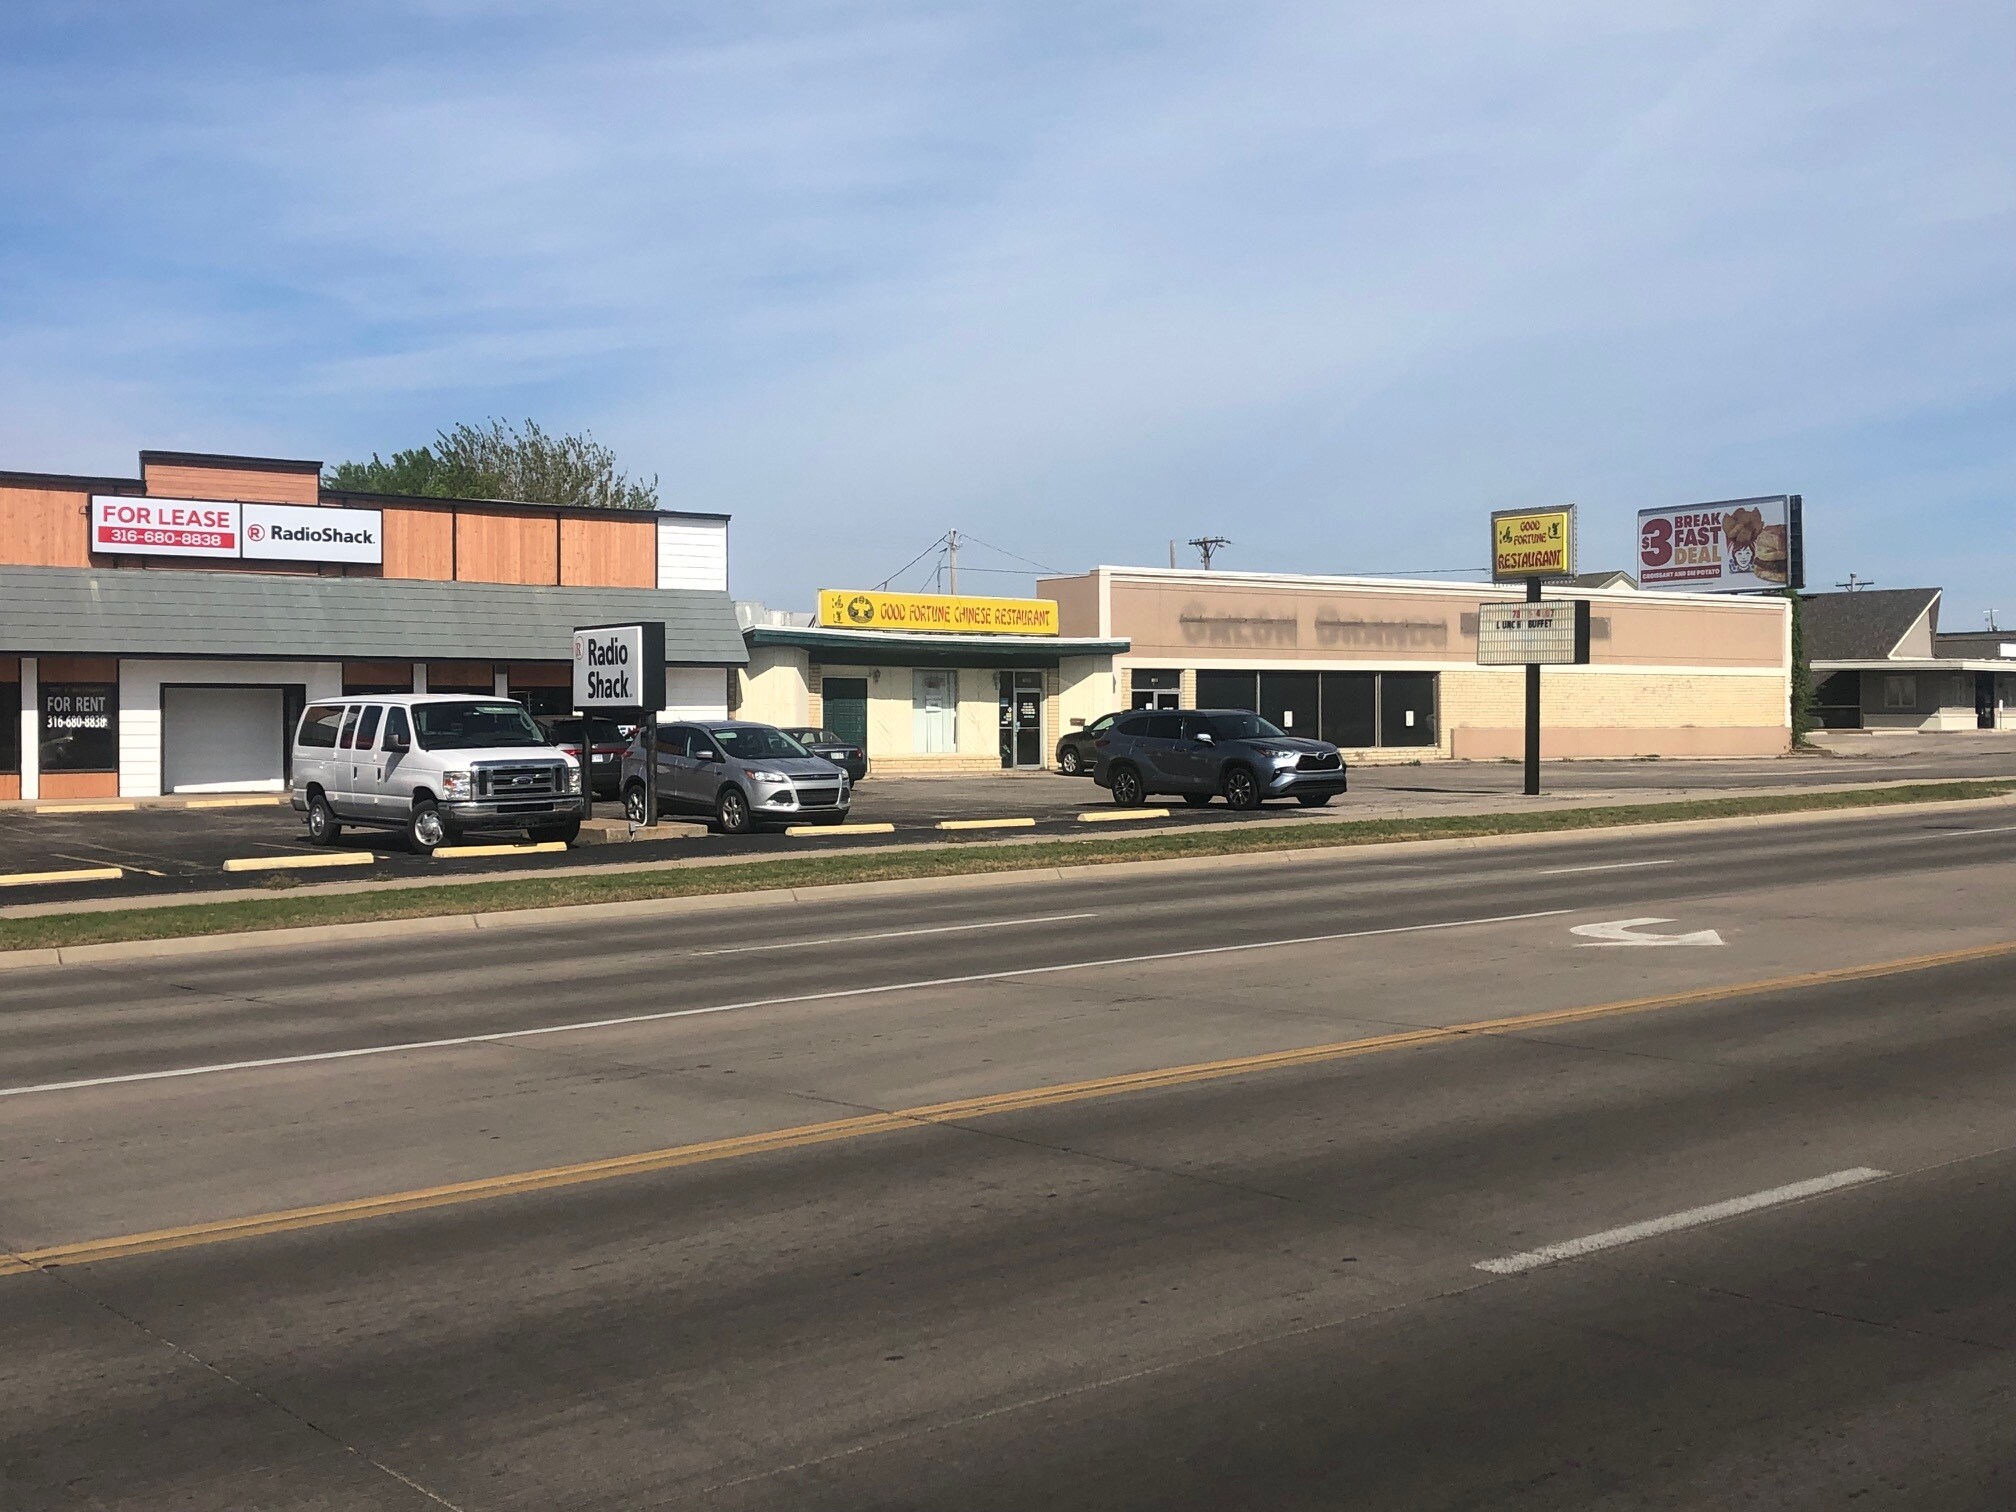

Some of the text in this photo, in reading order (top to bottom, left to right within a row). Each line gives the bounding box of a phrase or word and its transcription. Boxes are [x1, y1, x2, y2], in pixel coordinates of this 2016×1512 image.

[103, 505, 230, 528] FOR LEASE
[1674, 512, 1721, 529] BREAK
[1520, 520, 1540, 532] GOOD
[111, 529, 222, 546] 316-680-8838
[1513, 532, 1547, 545] FORTUNE
[1674, 526, 1721, 547] FAST
[1498, 549, 1562, 569] RESTAURANT
[1674, 545, 1721, 565] DEAL
[1696, 568, 1720, 576] POTATO
[881, 603, 1051, 627] GOOD FORTUNE CHINESE RESTAURANT
[1528, 619, 1553, 629] BUFFET
[588, 637, 628, 666] Radio
[47, 696, 106, 712] FOR RENT
[47, 714, 106, 728] 316-680-8838
